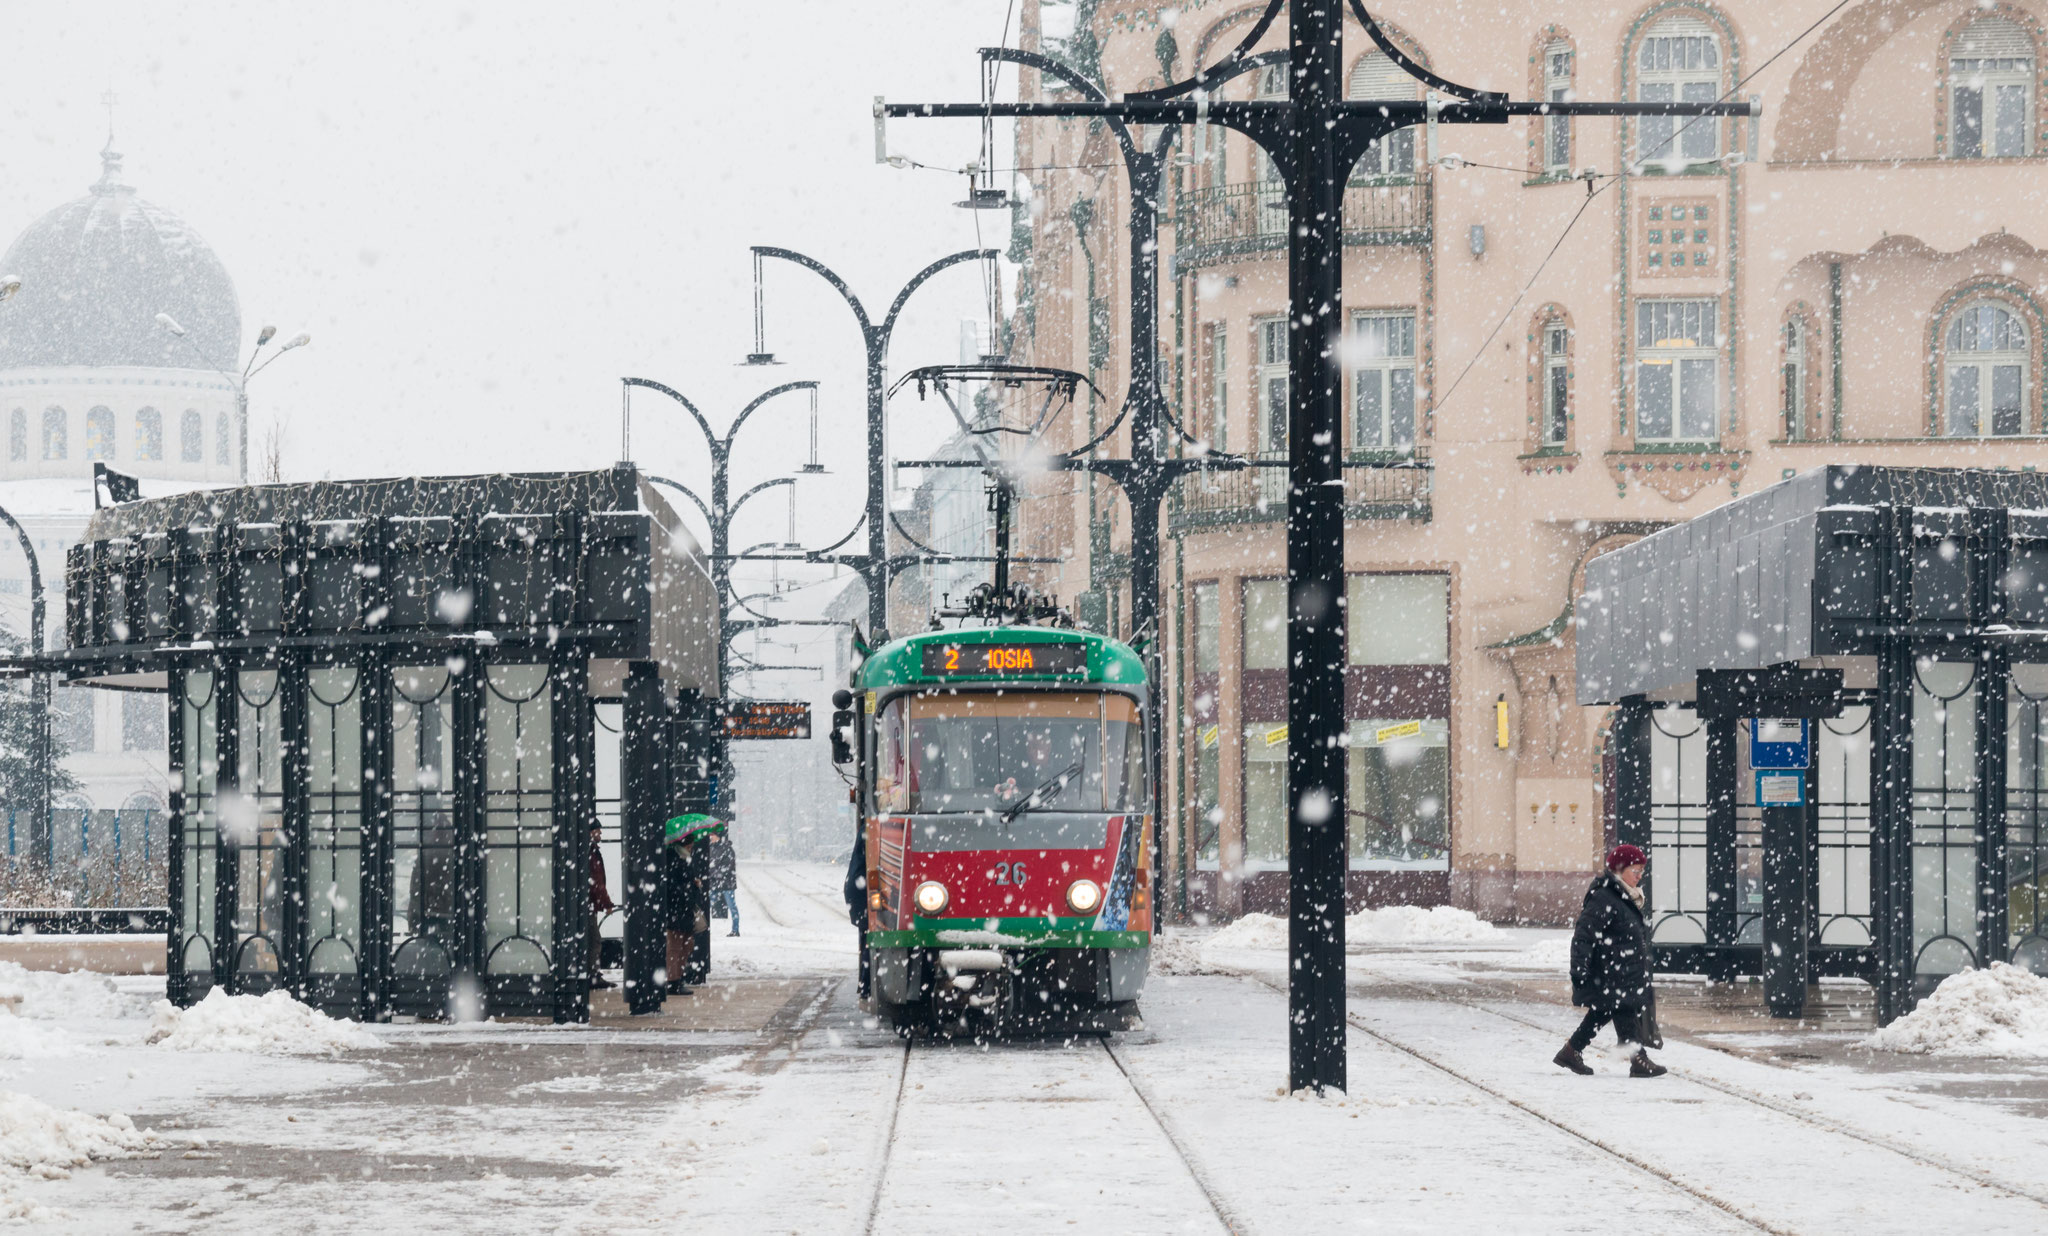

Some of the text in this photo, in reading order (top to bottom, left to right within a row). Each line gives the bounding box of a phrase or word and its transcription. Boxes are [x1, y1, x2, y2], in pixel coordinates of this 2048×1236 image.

[945, 648, 1033, 669] 2 IOSIA
[995, 861, 1026, 885] 26
